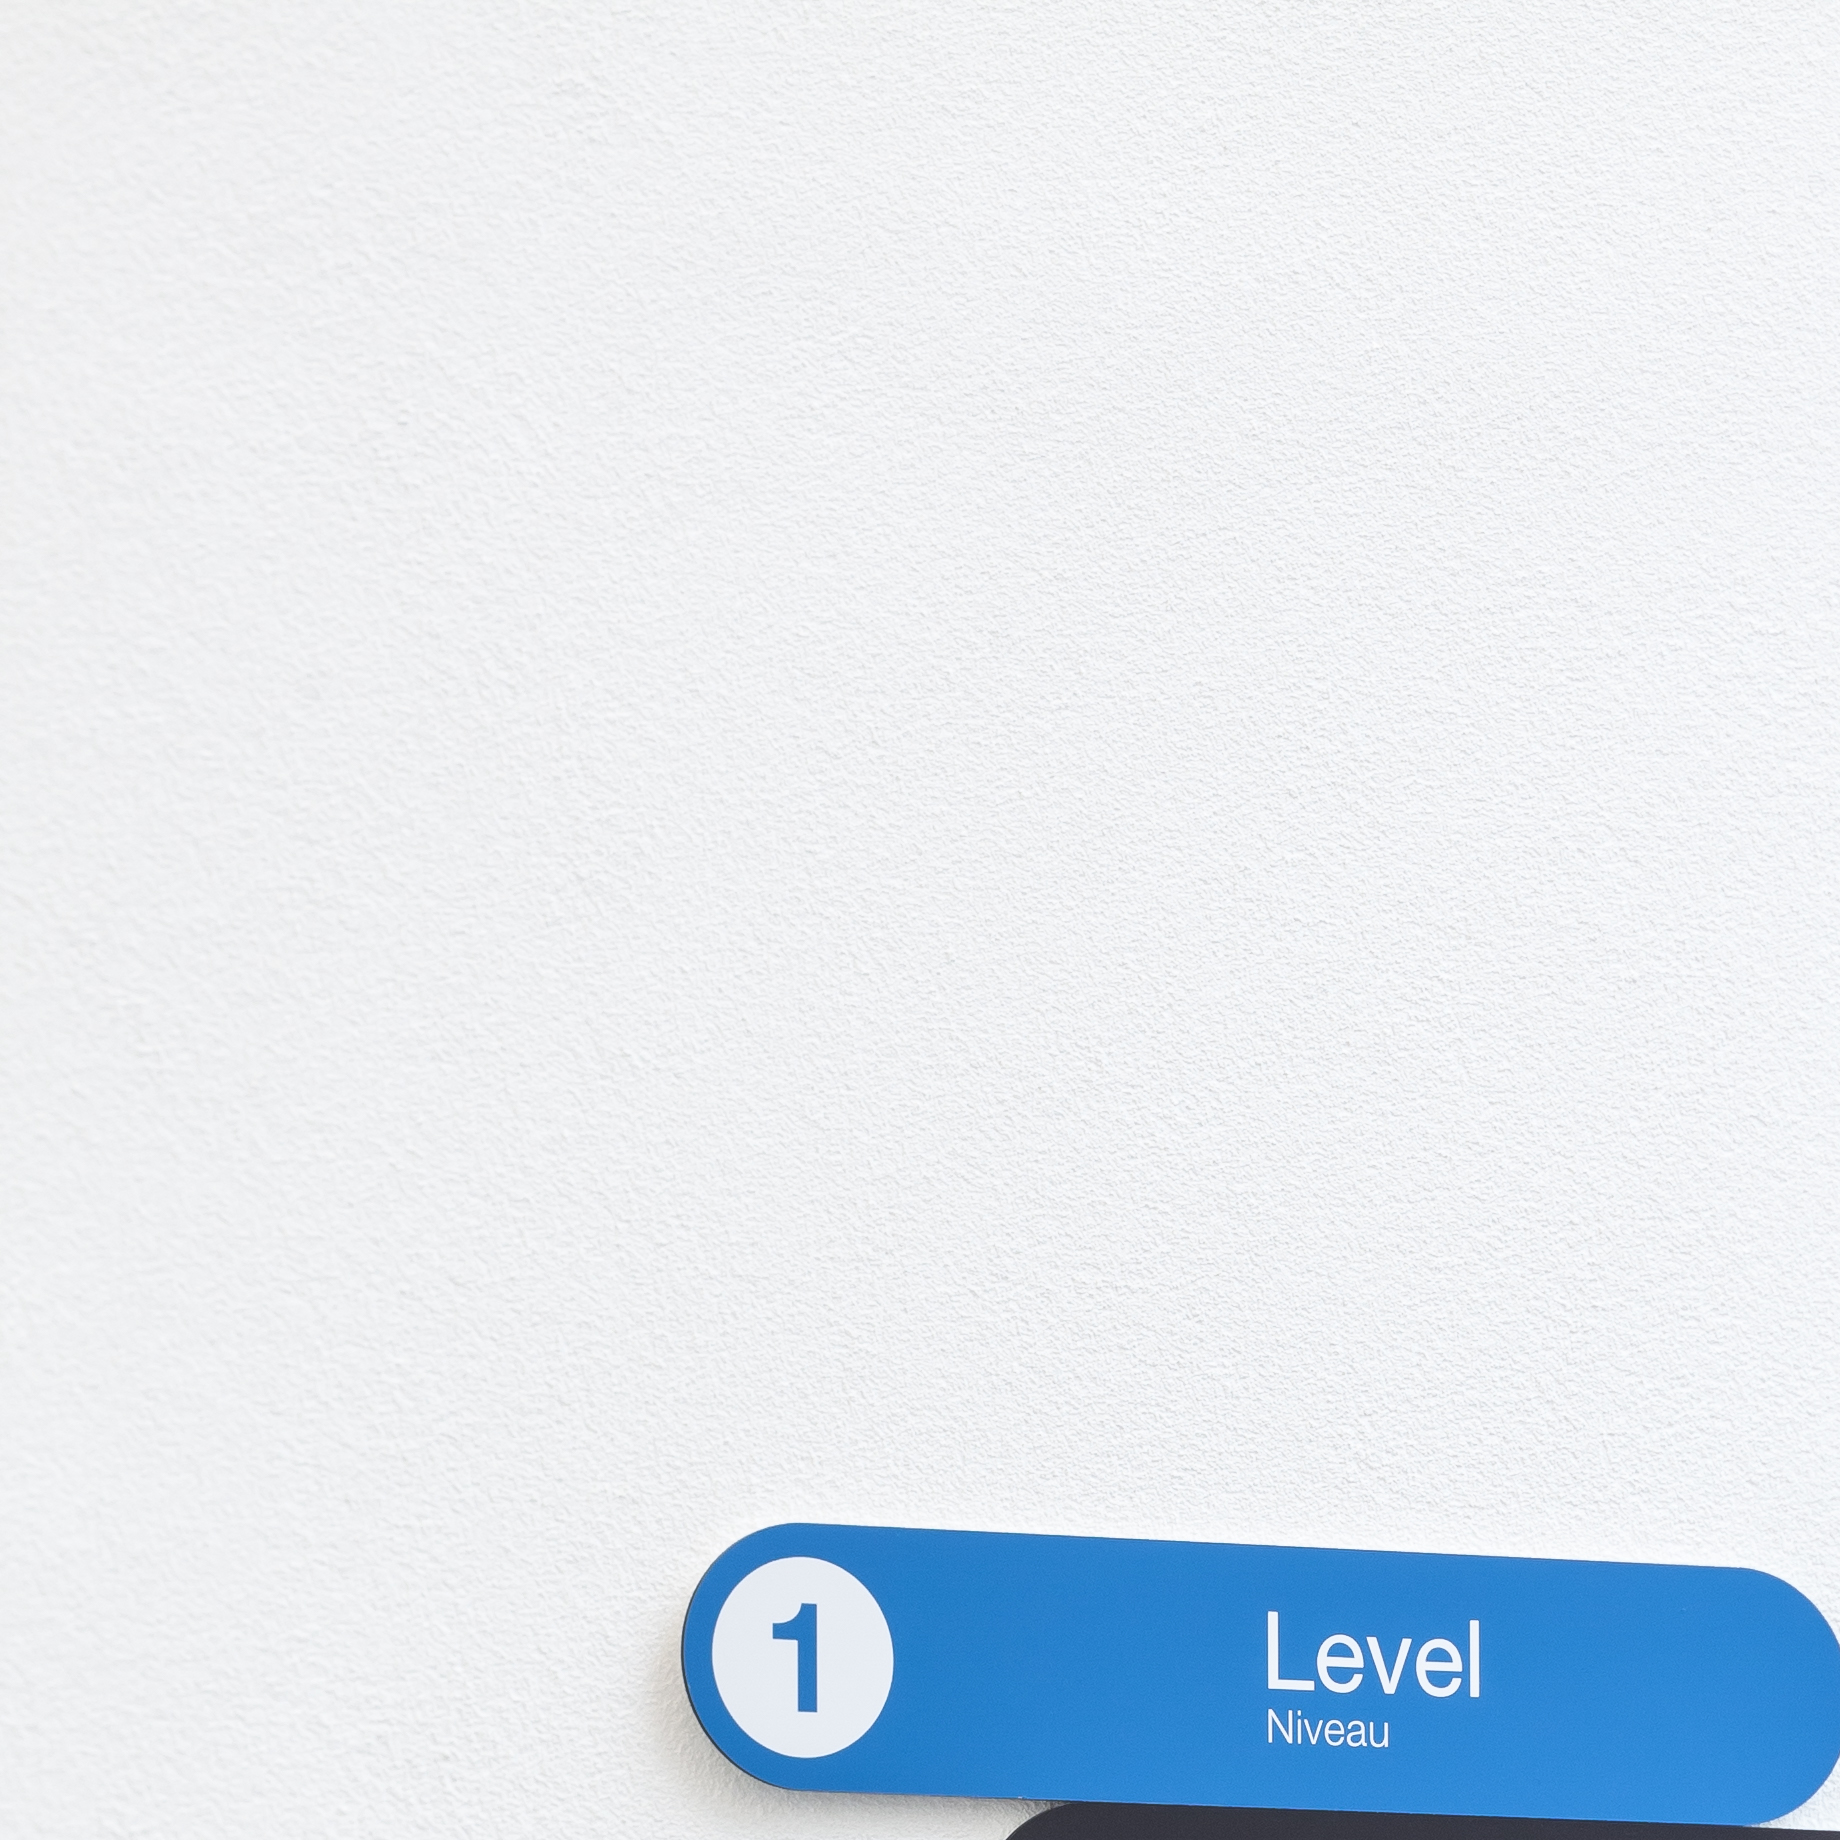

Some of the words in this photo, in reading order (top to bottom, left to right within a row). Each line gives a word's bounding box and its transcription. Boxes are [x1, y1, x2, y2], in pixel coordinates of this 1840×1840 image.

[772, 1602, 818, 1713] 1
[1267, 1610, 1480, 1698] Level
[1267, 1708, 1389, 1748] Niveau
